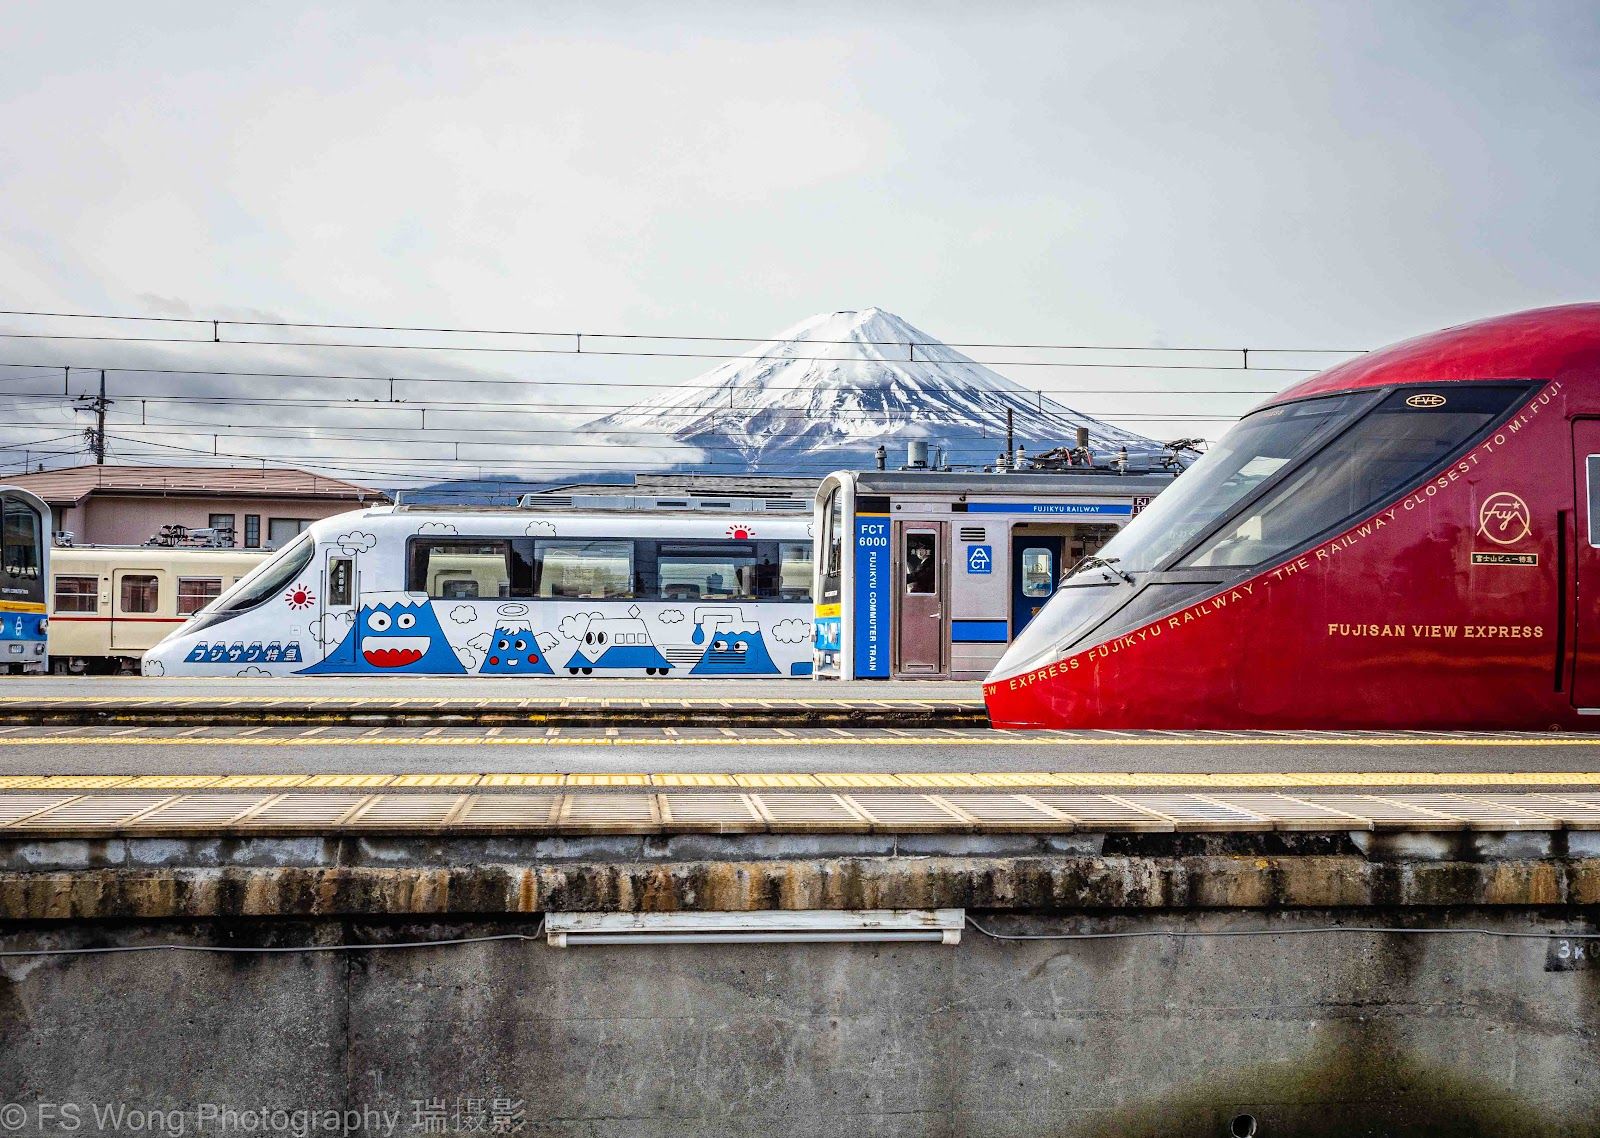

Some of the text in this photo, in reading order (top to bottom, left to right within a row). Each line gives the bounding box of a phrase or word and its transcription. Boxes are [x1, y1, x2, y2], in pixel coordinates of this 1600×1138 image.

[1136, 498, 1147, 506] FJ
[861, 524, 885, 535] FCT
[859, 536, 887, 547] 6000
[1010, 658, 1080, 690] EXPRESS
[1088, 626, 1162, 662] FUJIKYU
[1168, 583, 1254, 629] RAILWAY
[1273, 558, 1310, 582] THE
[1316, 509, 1398, 560] RAILWAY
[1404, 454, 1478, 511] CLOSEST
[1482, 434, 1505, 452] TO
[1328, 624, 1544, 639] FUJISAN VIEW EXPRESS
[194, 648, 297, 662] フジサン特急
